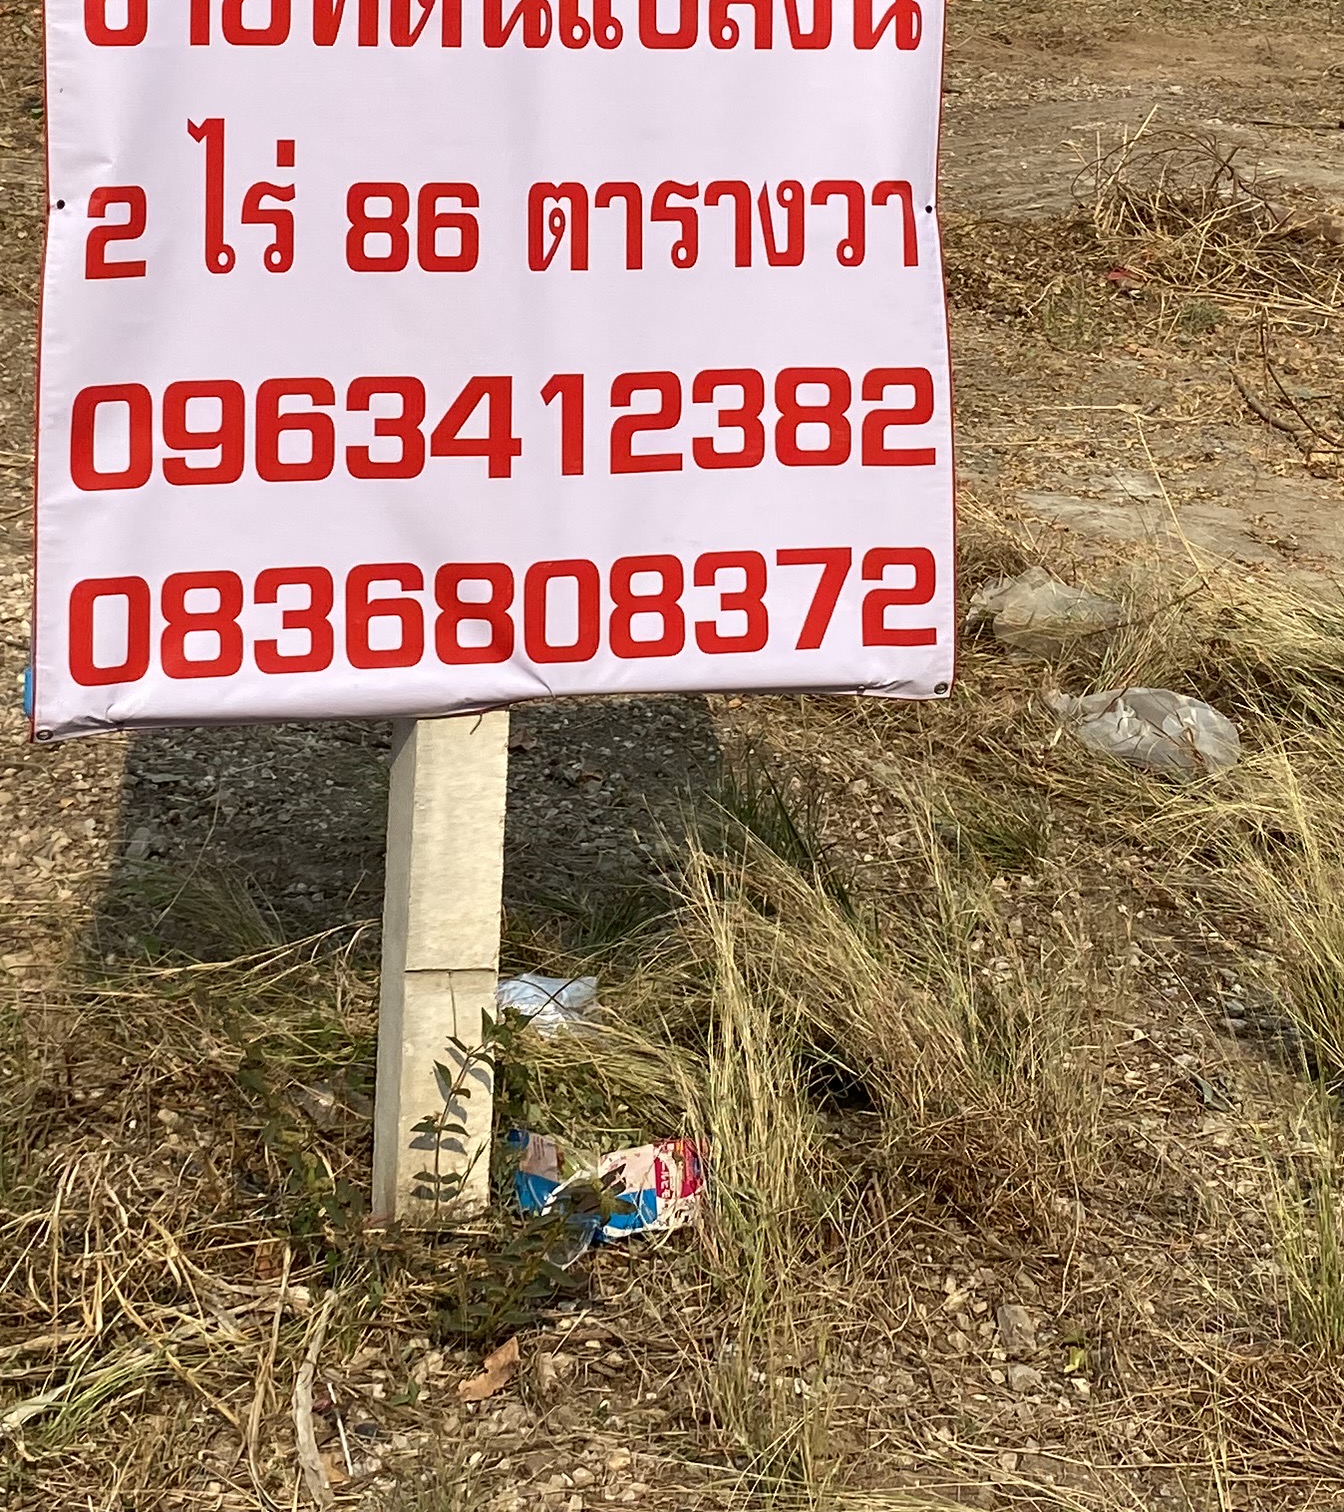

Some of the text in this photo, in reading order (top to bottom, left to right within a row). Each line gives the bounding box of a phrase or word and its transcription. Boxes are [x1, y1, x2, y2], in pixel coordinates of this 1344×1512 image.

[84, 117, 919, 281] 2 ไร่ 86 ตารางวา
[69, 366, 937, 492] 0963412382
[67, 546, 938, 688] 0836808372
